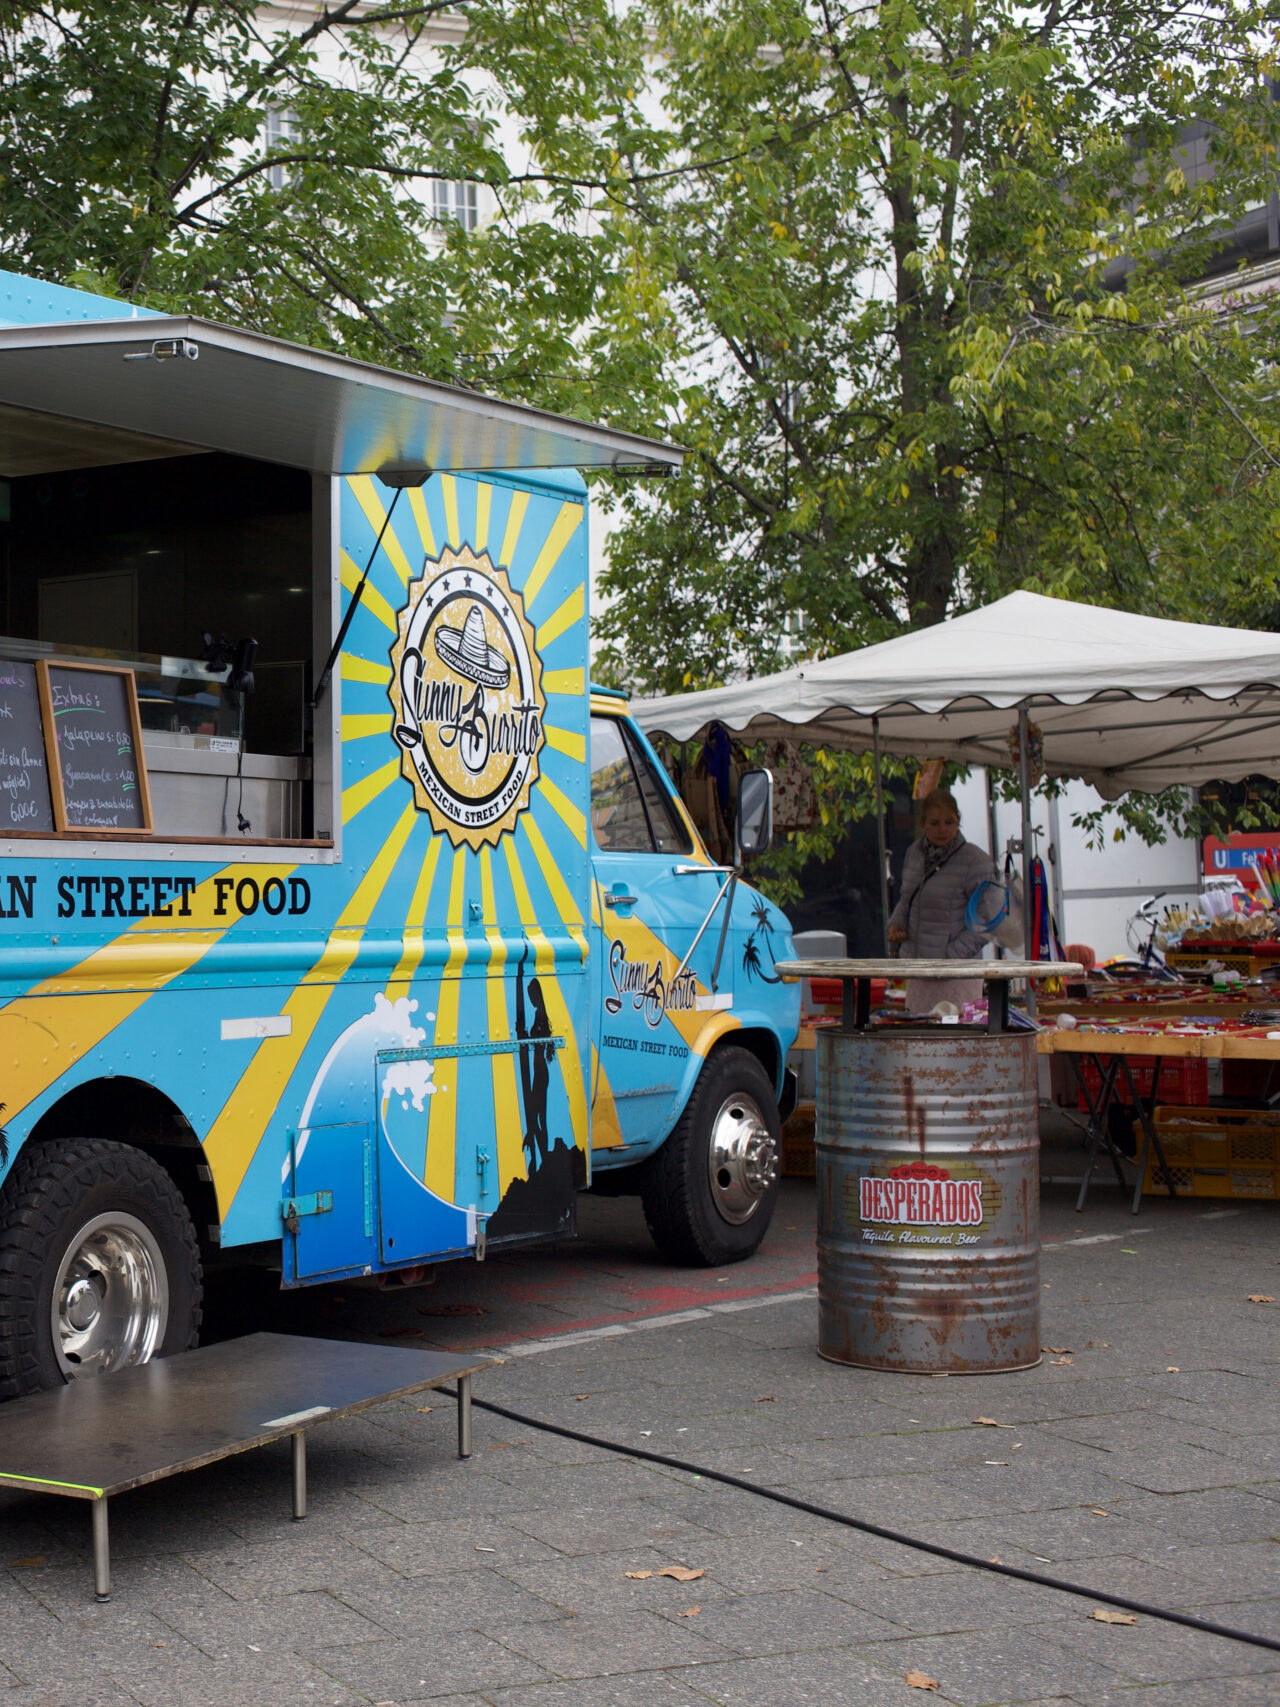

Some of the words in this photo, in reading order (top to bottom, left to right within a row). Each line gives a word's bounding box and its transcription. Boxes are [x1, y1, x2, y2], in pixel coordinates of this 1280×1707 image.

[396, 647, 463, 748] Sunny
[460, 683, 541, 773] Burrito
[10, 800, 38, 822] 6,00€
[419, 762, 461, 819] MEXICAN
[465, 802, 499, 823] STREET
[502, 770, 523, 805] FOOD
[1214, 850, 1227, 868] U
[57, 877, 195, 917] STREET
[213, 877, 311, 916] FOOD
[605, 938, 650, 1014] Sunny
[603, 1036, 637, 1050] MEXICAN
[640, 1041, 666, 1055] STREET
[669, 1045, 688, 1058] FOOD
[861, 1178, 982, 1223] DESPERADOS
[861, 1228, 895, 1244] Tequila
[955, 1232, 981, 1246] Beer
